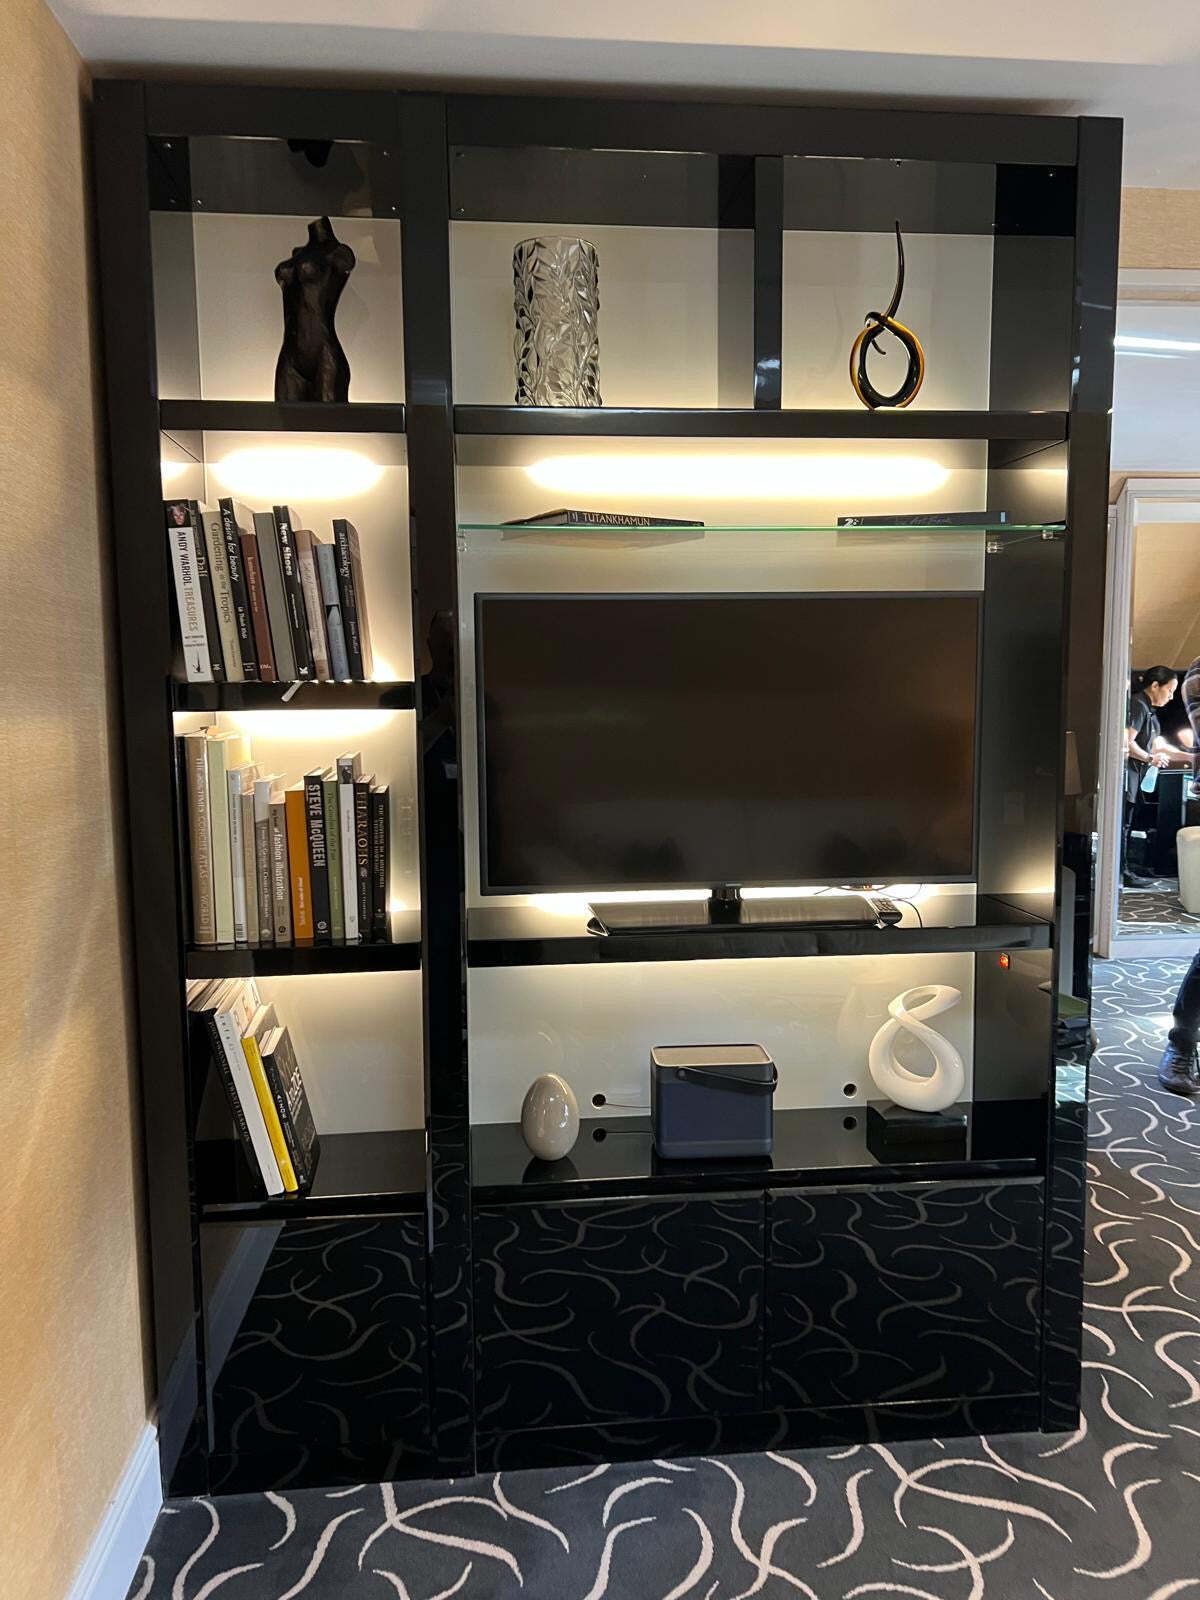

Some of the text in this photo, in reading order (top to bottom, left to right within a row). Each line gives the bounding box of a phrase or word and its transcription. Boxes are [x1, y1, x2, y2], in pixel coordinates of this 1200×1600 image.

[224, 517, 233, 540] desire
[583, 513, 650, 526] TUTANKHAMUN
[176, 531, 188, 551] ANDY
[228, 542, 236, 553] for
[279, 522, 292, 575] New Shoes
[339, 532, 350, 577] archaeology
[179, 553, 191, 585] WARHOL
[210, 522, 226, 571] Gardening
[220, 591, 233, 623] Tropics
[229, 555, 239, 581] beauty
[184, 587, 198, 631] TREASURES
[307, 783, 325, 867] STEVE McQUEEN
[355, 791, 369, 865] PHARAOHS
[272, 832, 283, 860] fashion
[198, 854, 208, 879] ATLAS
[274, 861, 285, 900] illustration
[199, 894, 209, 924] WORLD
